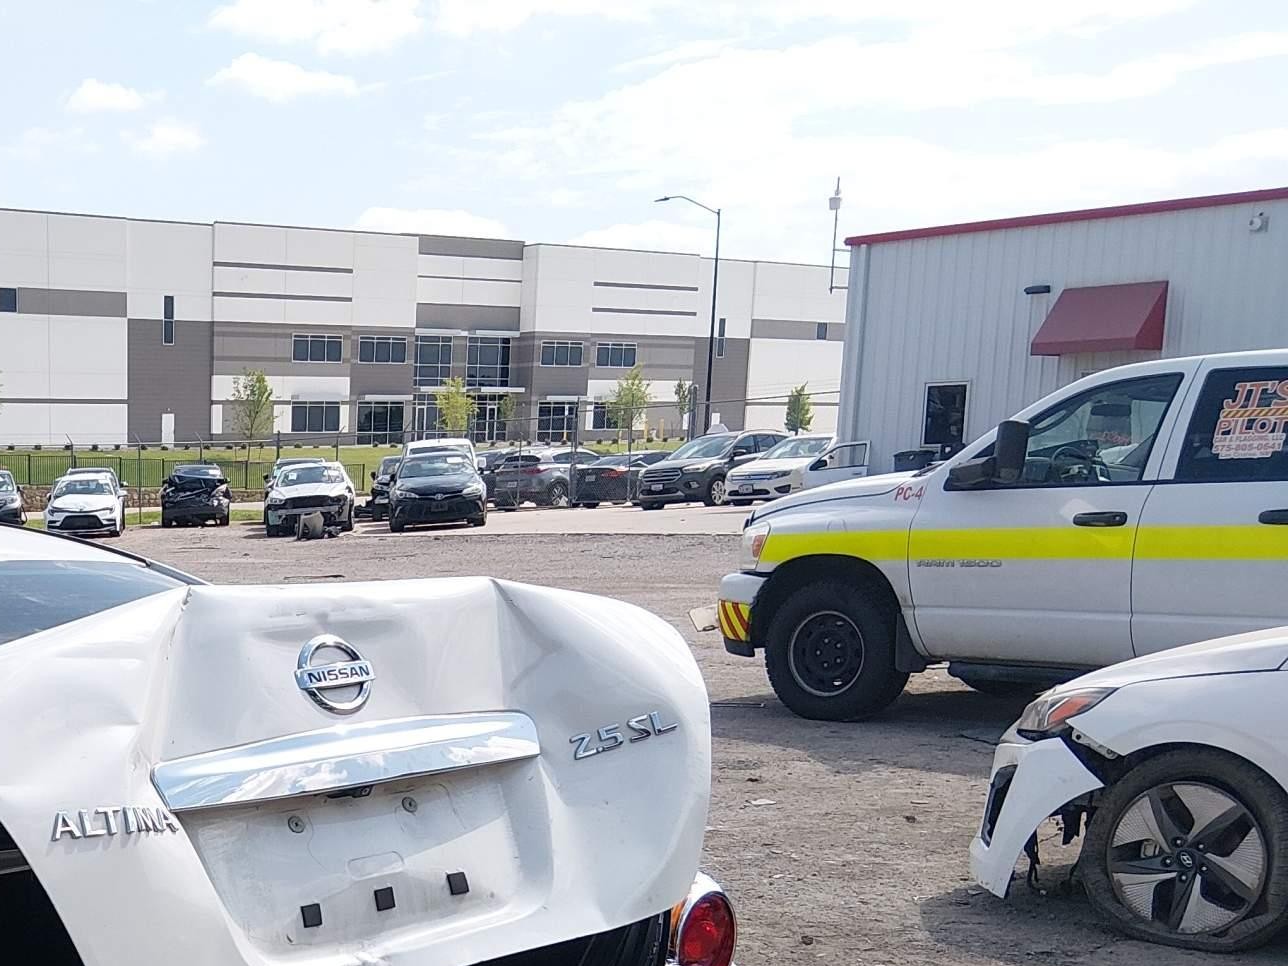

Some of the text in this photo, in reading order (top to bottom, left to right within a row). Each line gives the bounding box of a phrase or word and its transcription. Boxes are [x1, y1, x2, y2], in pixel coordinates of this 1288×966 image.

[1214, 417, 1288, 436] PILOT
[958, 559, 1003, 568] 1500
[307, 664, 371, 684] NISSAN
[568, 710, 679, 761] 2.5 SL
[50, 804, 179, 842] ALTIMA
